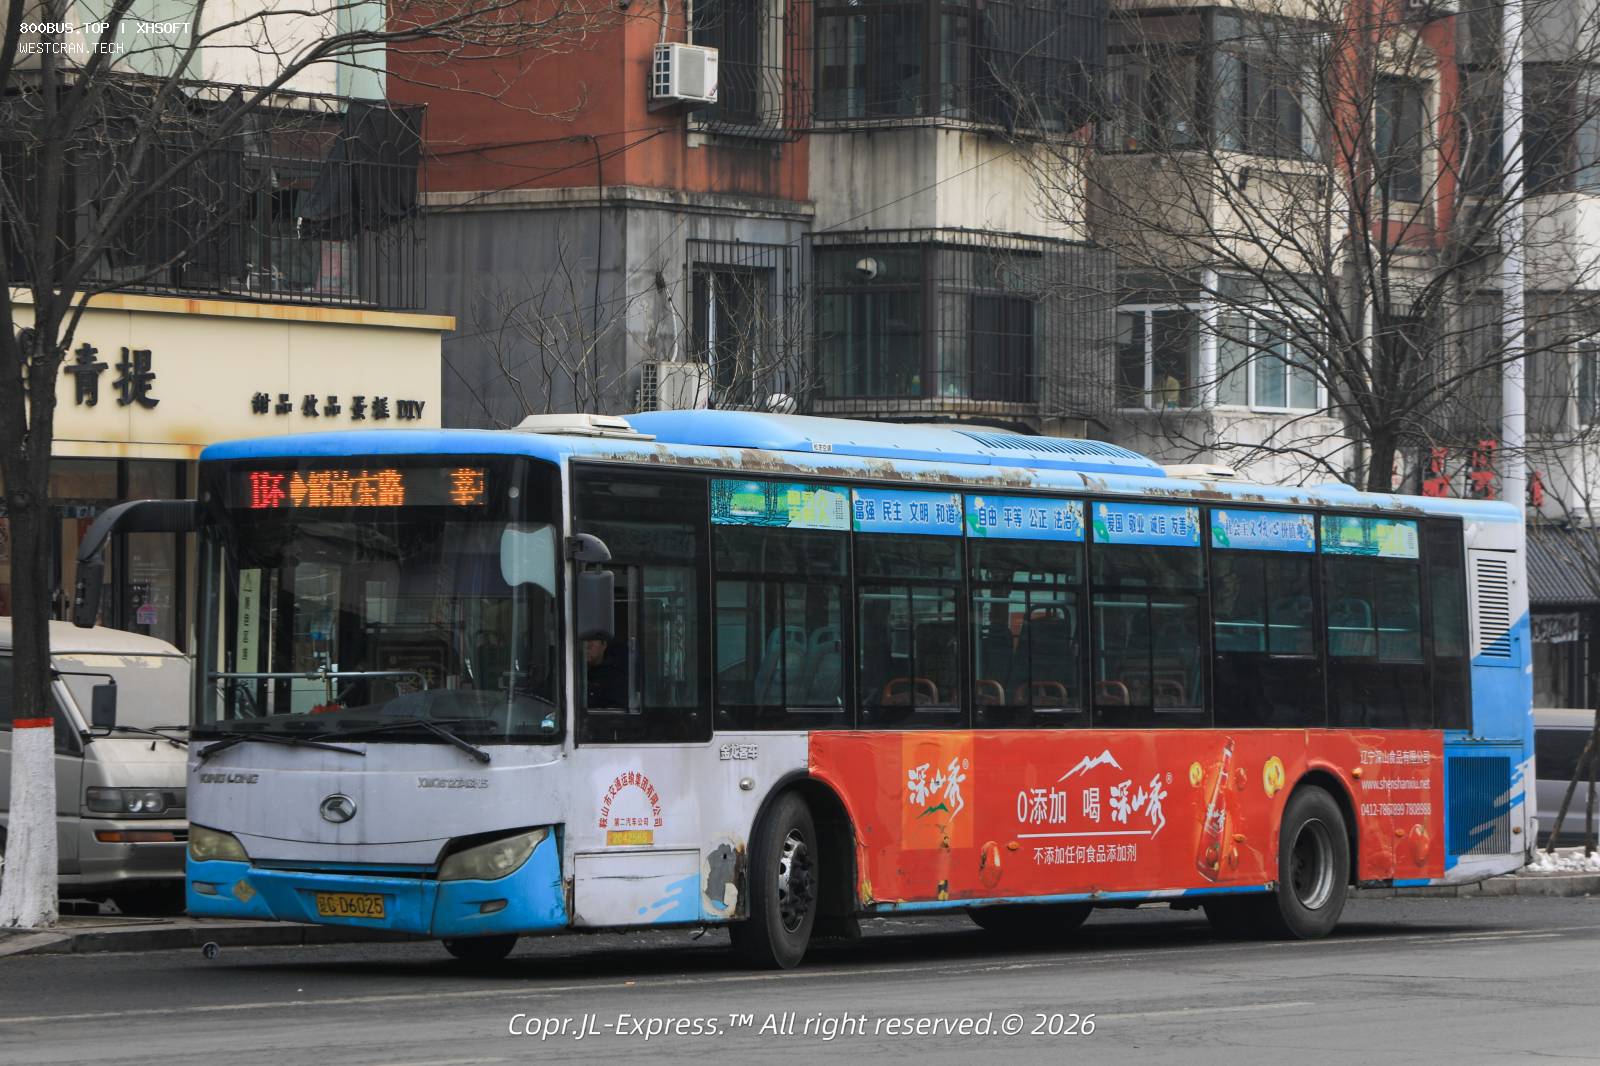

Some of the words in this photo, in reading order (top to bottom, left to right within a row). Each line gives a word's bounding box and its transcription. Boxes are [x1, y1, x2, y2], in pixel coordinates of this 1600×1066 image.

[64, 343, 160, 410] 青提
[396, 399, 426, 420] DIY
[854, 499, 875, 522] 富强
[882, 501, 902, 522] 民主
[909, 502, 929, 523] 文明
[935, 504, 956, 524] 和谐
[977, 506, 997, 527] 自由
[1003, 507, 1023, 528] 平等
[1029, 508, 1048, 529] 公正
[1053, 510, 1073, 530] 法治
[1106, 513, 1123, 532] 爱国
[1128, 514, 1145, 533] 敬业
[1150, 515, 1166, 534] 诚信
[1171, 516, 1187, 536] 友善
[1017, 787, 1067, 825] 0添加
[1083, 787, 1100, 824] 喝
[1033, 844, 1137, 865] 不添加任何食品添加剂
